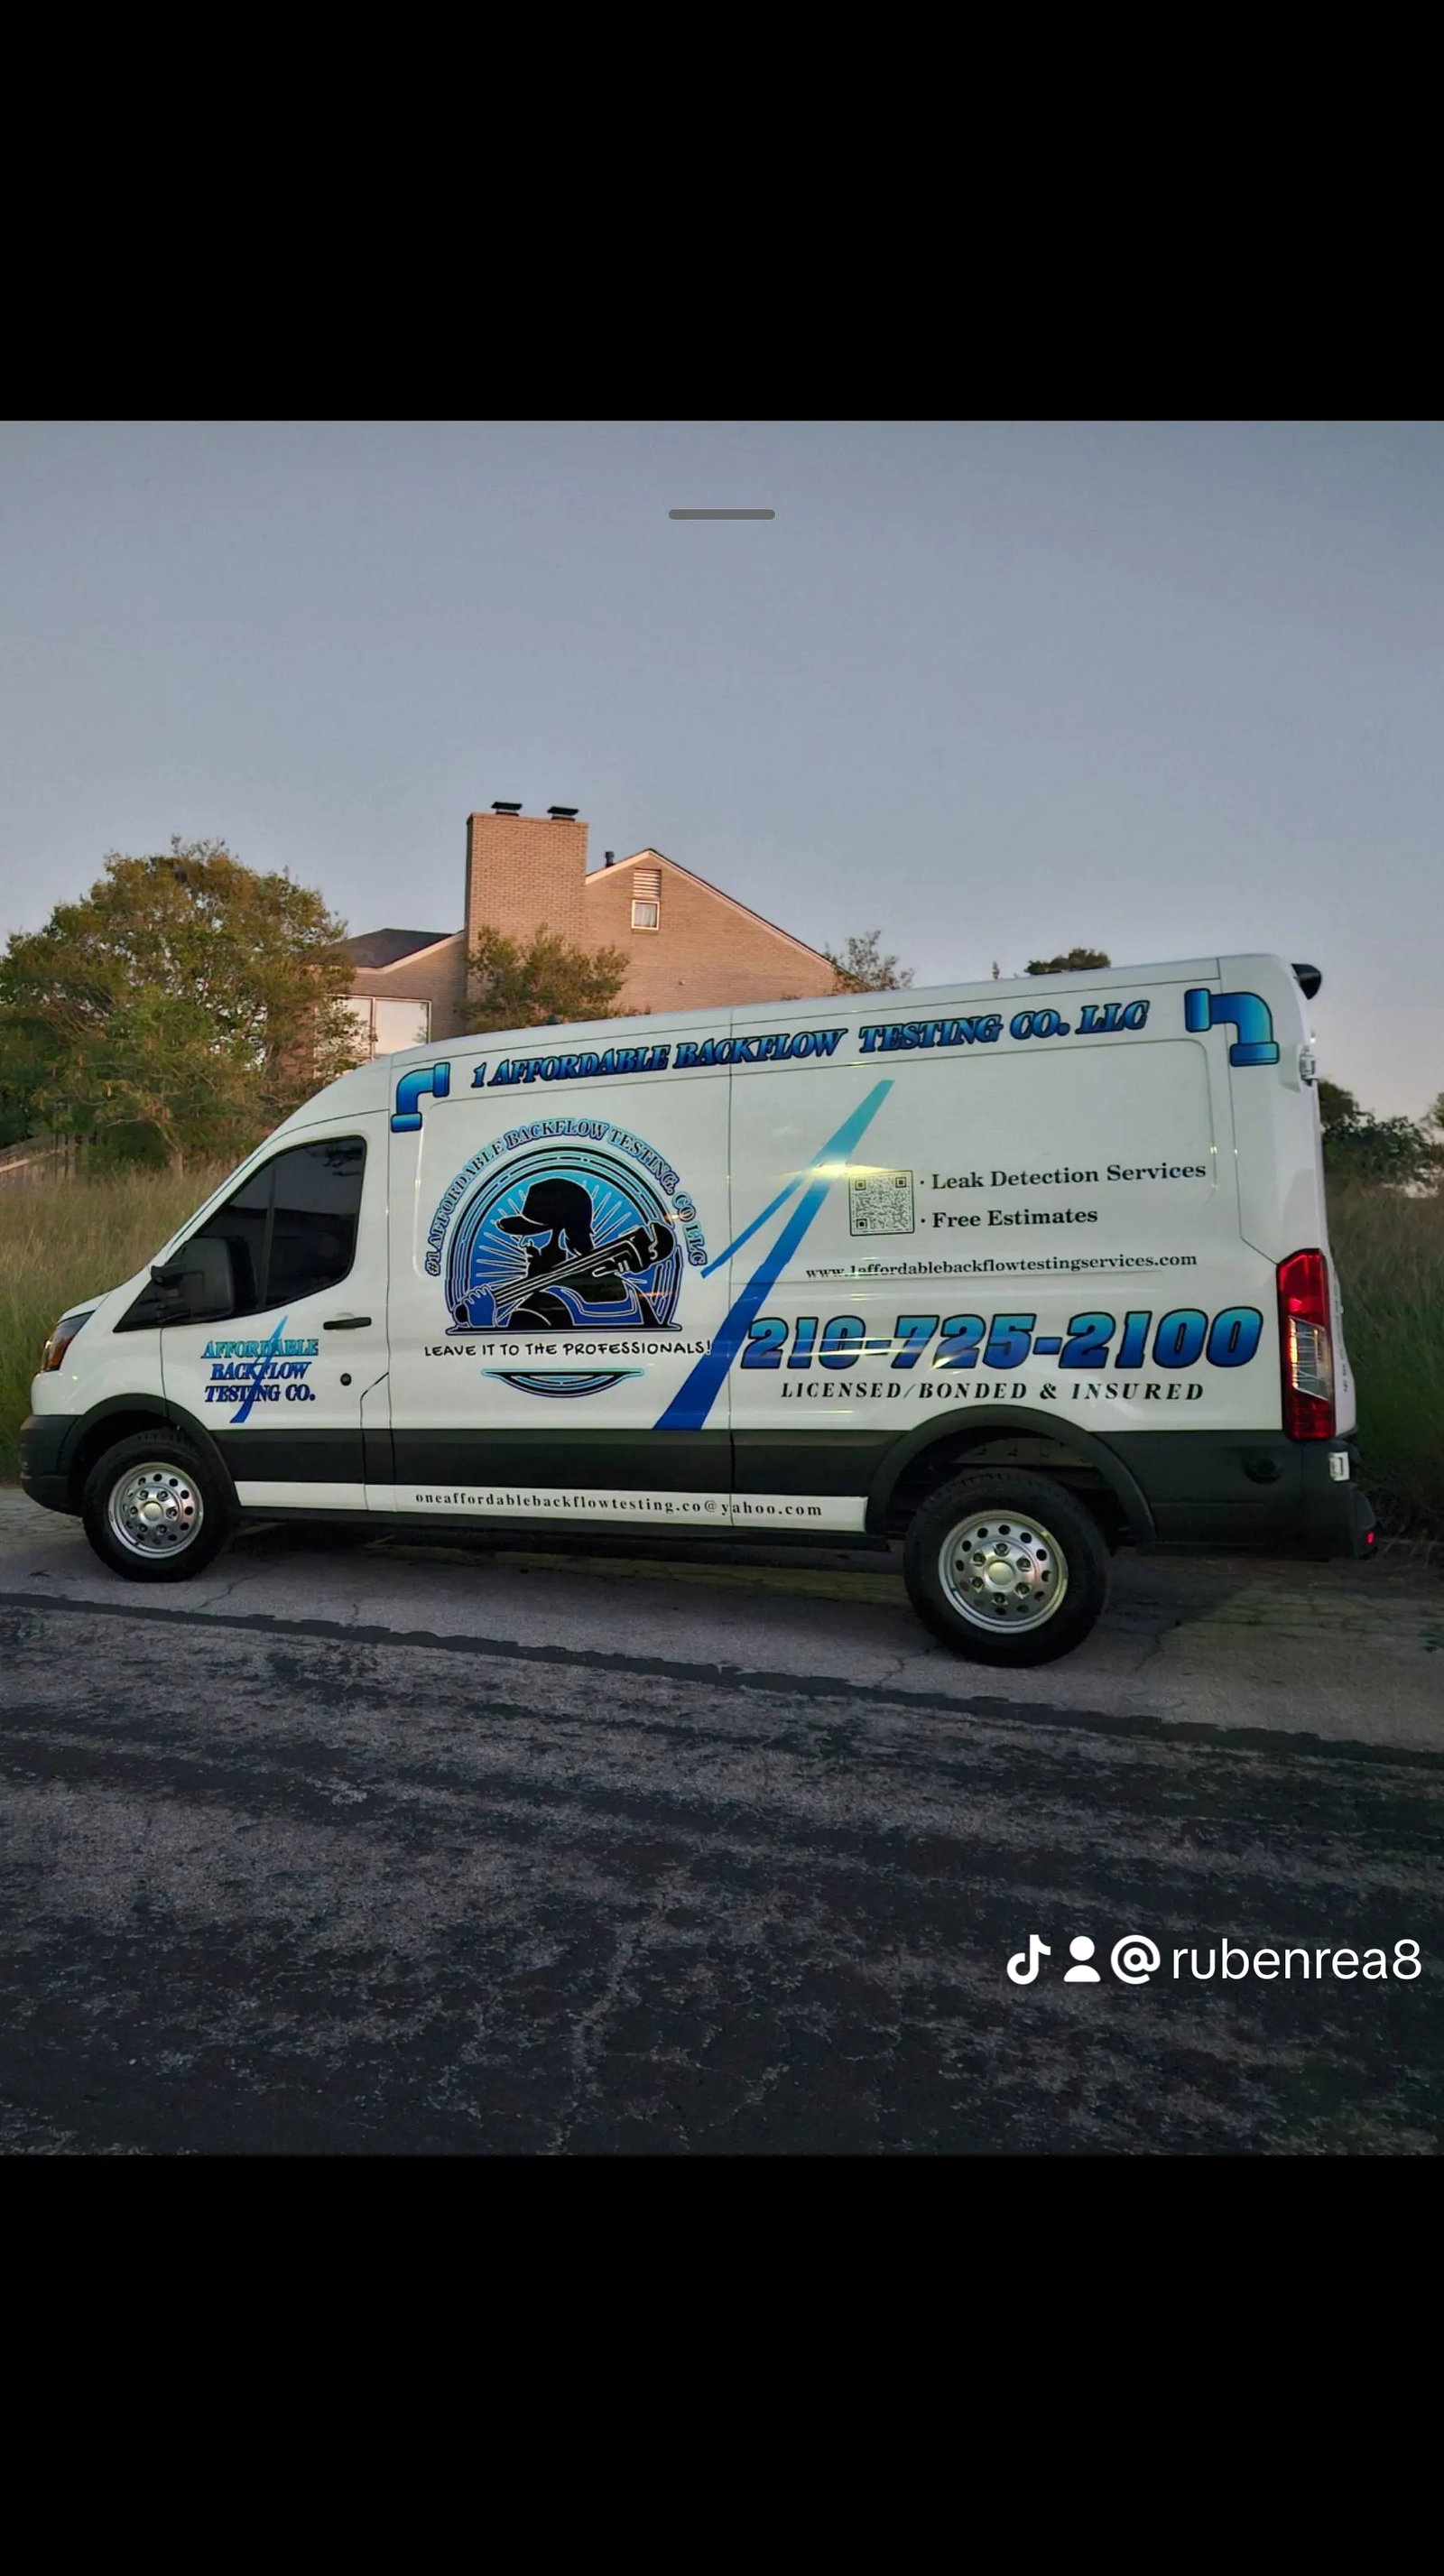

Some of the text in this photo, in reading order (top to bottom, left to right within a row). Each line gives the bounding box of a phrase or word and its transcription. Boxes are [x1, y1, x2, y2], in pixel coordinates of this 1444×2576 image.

[471, 1000, 1150, 1088] 1 AFFORDABLE BACKFLOW TESTING CO. LLC
[504, 1118, 610, 1150] BACKFLOW
[931, 1163, 1207, 1190] Leak Detection Services
[672, 1191, 697, 1222] CO
[931, 1208, 1098, 1228] Free Estimates
[683, 1221, 708, 1265] LLC
[806, 1253, 1198, 1278] www.1affordablebackflowtestingservices.com
[200, 1339, 319, 1359] AFFORDABLE
[424, 1339, 711, 1357] LEAVE IT TO THE PROFESSIONALS!
[740, 1306, 1264, 1370] 210-725-2100
[209, 1361, 312, 1381] BACKFLOW
[285, 1383, 316, 1402] CO.
[781, 1381, 1205, 1401] LICENSED/BONDED & INSURED
[415, 1491, 822, 1516] oneaffordablebackflowtesting.co@yahoo.com
